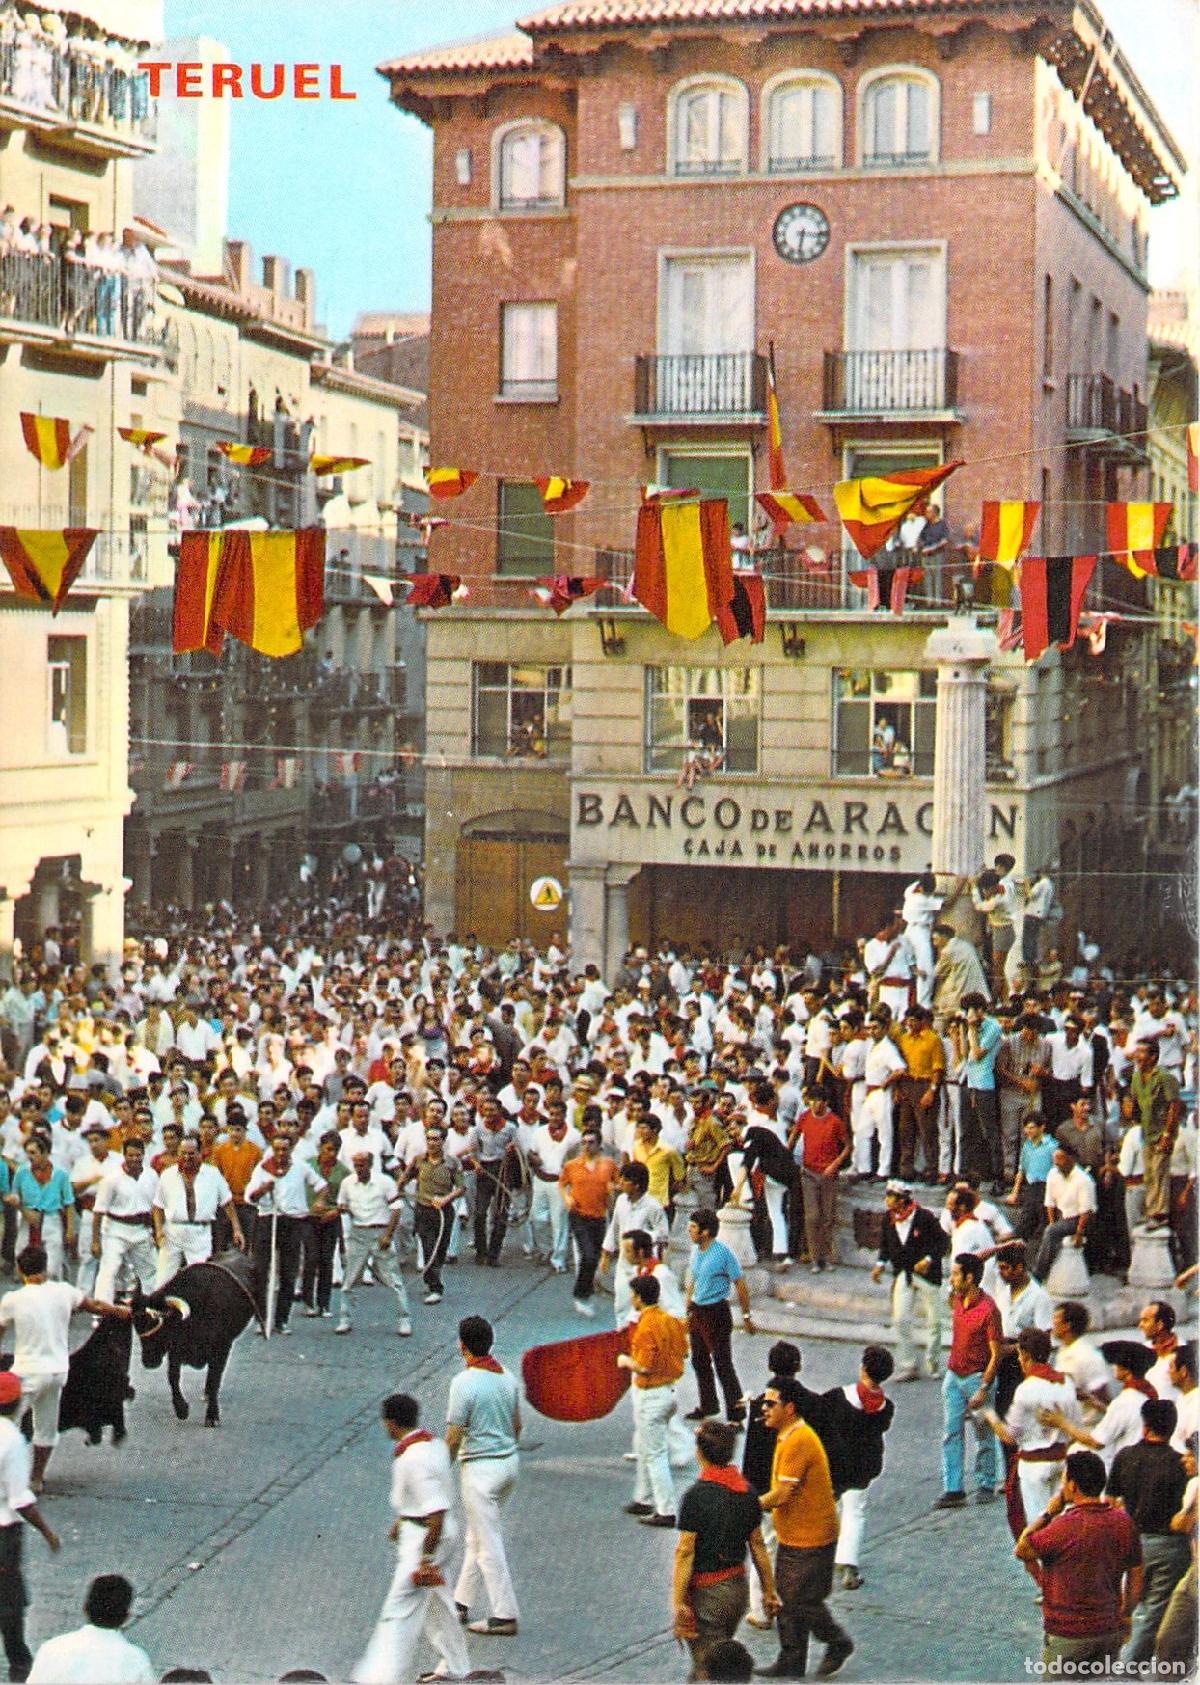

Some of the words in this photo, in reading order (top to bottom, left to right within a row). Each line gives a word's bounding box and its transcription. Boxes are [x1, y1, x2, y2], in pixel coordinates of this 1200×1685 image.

[576, 792, 742, 830] BANCO
[750, 808, 793, 832] DE
[803, 799, 1019, 839] ARAN
[684, 837, 743, 857] CAJA
[790, 841, 901, 863] AHORROS
